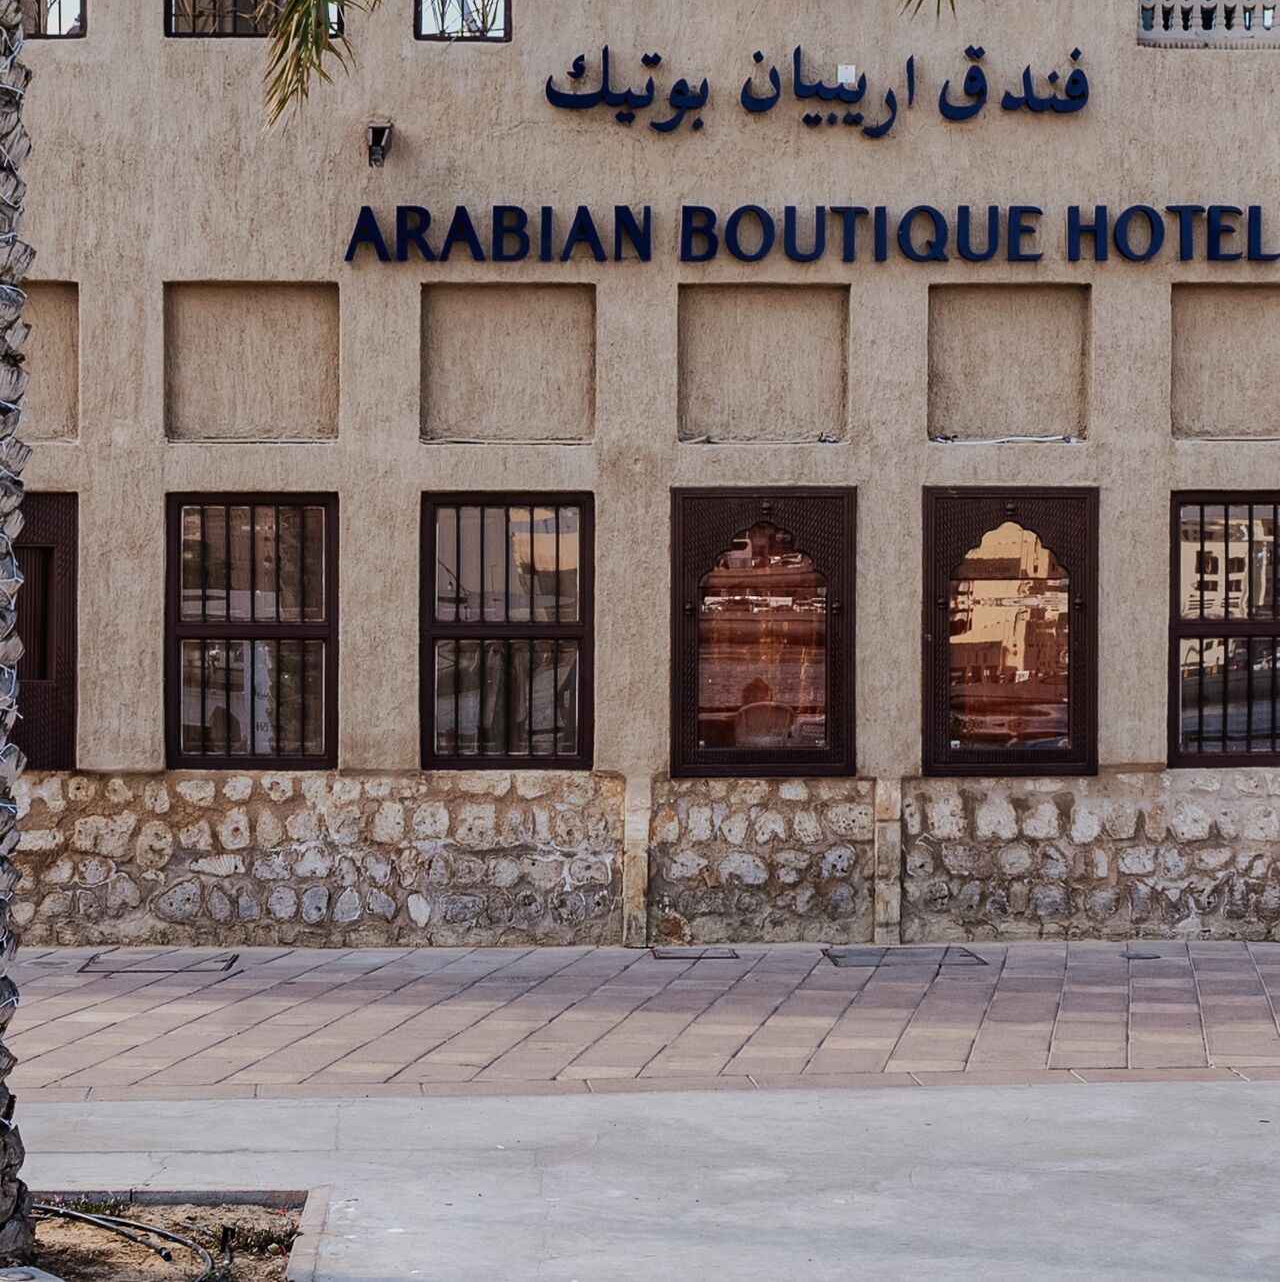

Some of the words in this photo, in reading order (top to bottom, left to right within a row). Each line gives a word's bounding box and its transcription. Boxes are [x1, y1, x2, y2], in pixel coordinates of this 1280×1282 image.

[545, 45, 709, 132] بوتيك
[740, 45, 915, 137] اريبيان
[938, 44, 1090, 121] فندق
[344, 205, 652, 263] ARABIAN
[680, 204, 1044, 263] BOUTIQUE
